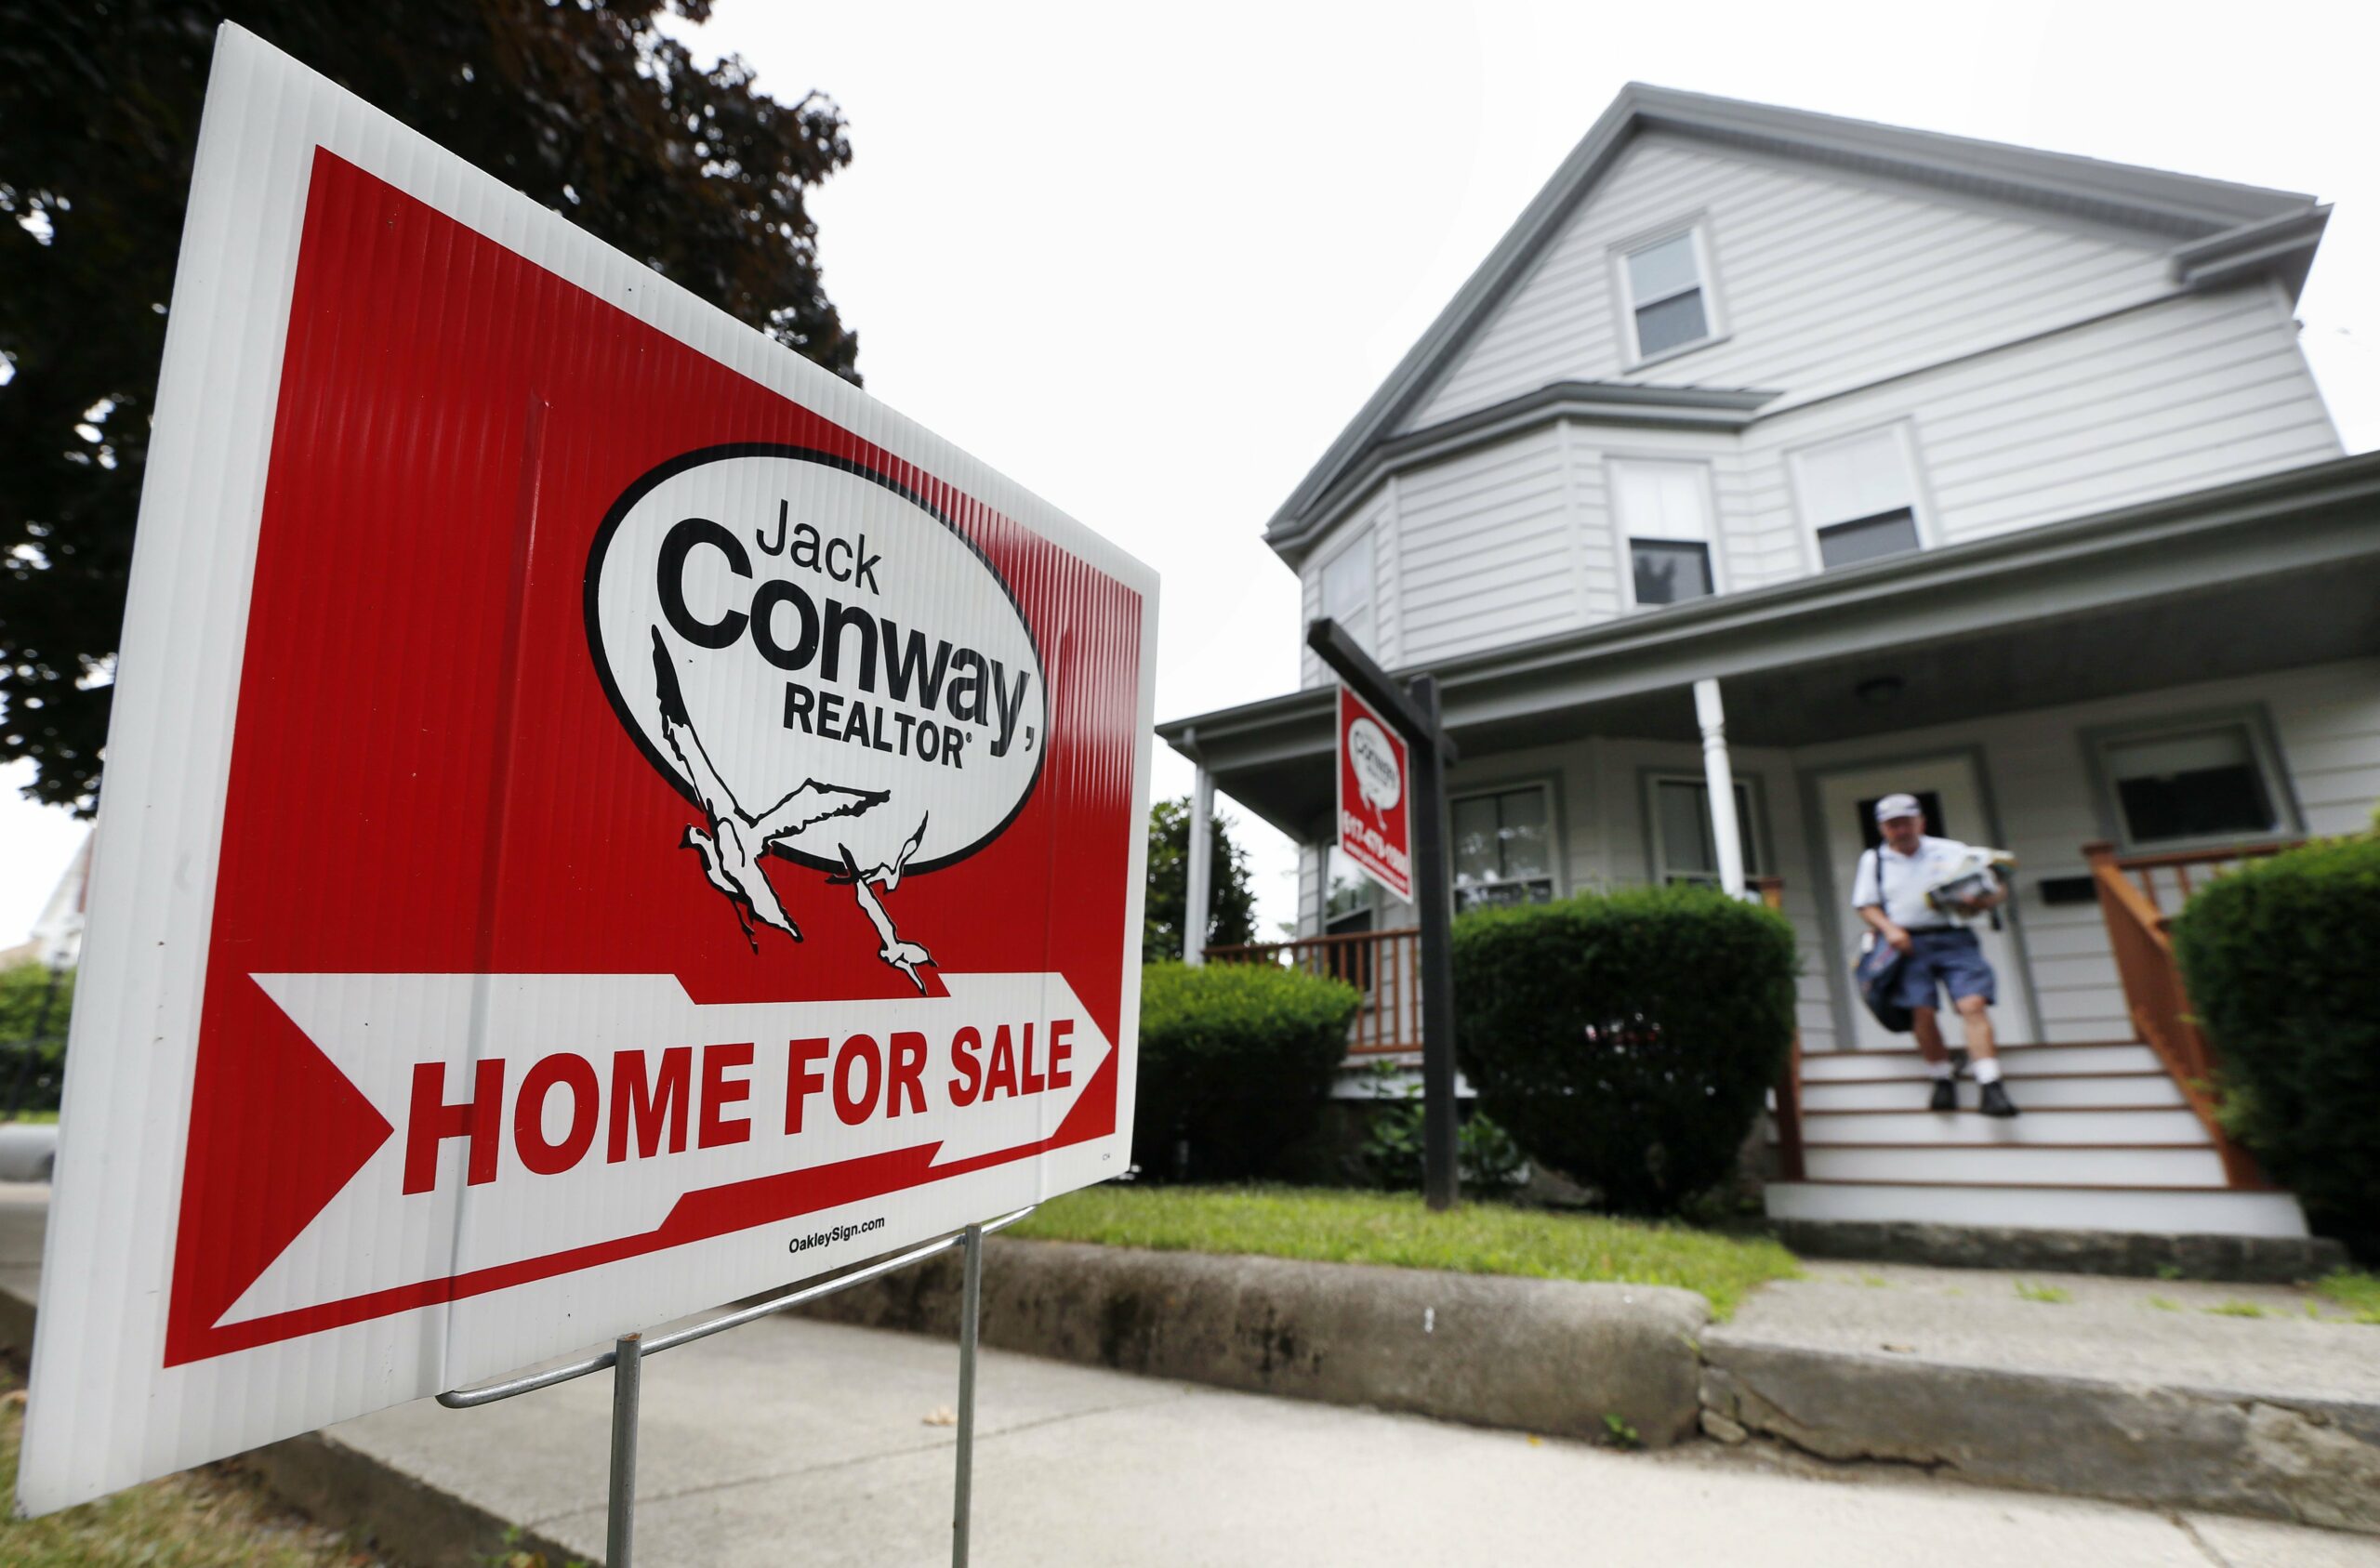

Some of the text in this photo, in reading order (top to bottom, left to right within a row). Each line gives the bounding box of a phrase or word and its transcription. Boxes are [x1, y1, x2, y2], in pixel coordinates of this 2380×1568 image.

[756, 498, 882, 596] Jack
[656, 517, 1035, 758] Conway,
[403, 1019, 1075, 1195] HOME FOR SALE
[788, 1217, 886, 1254] OakleySign.com
